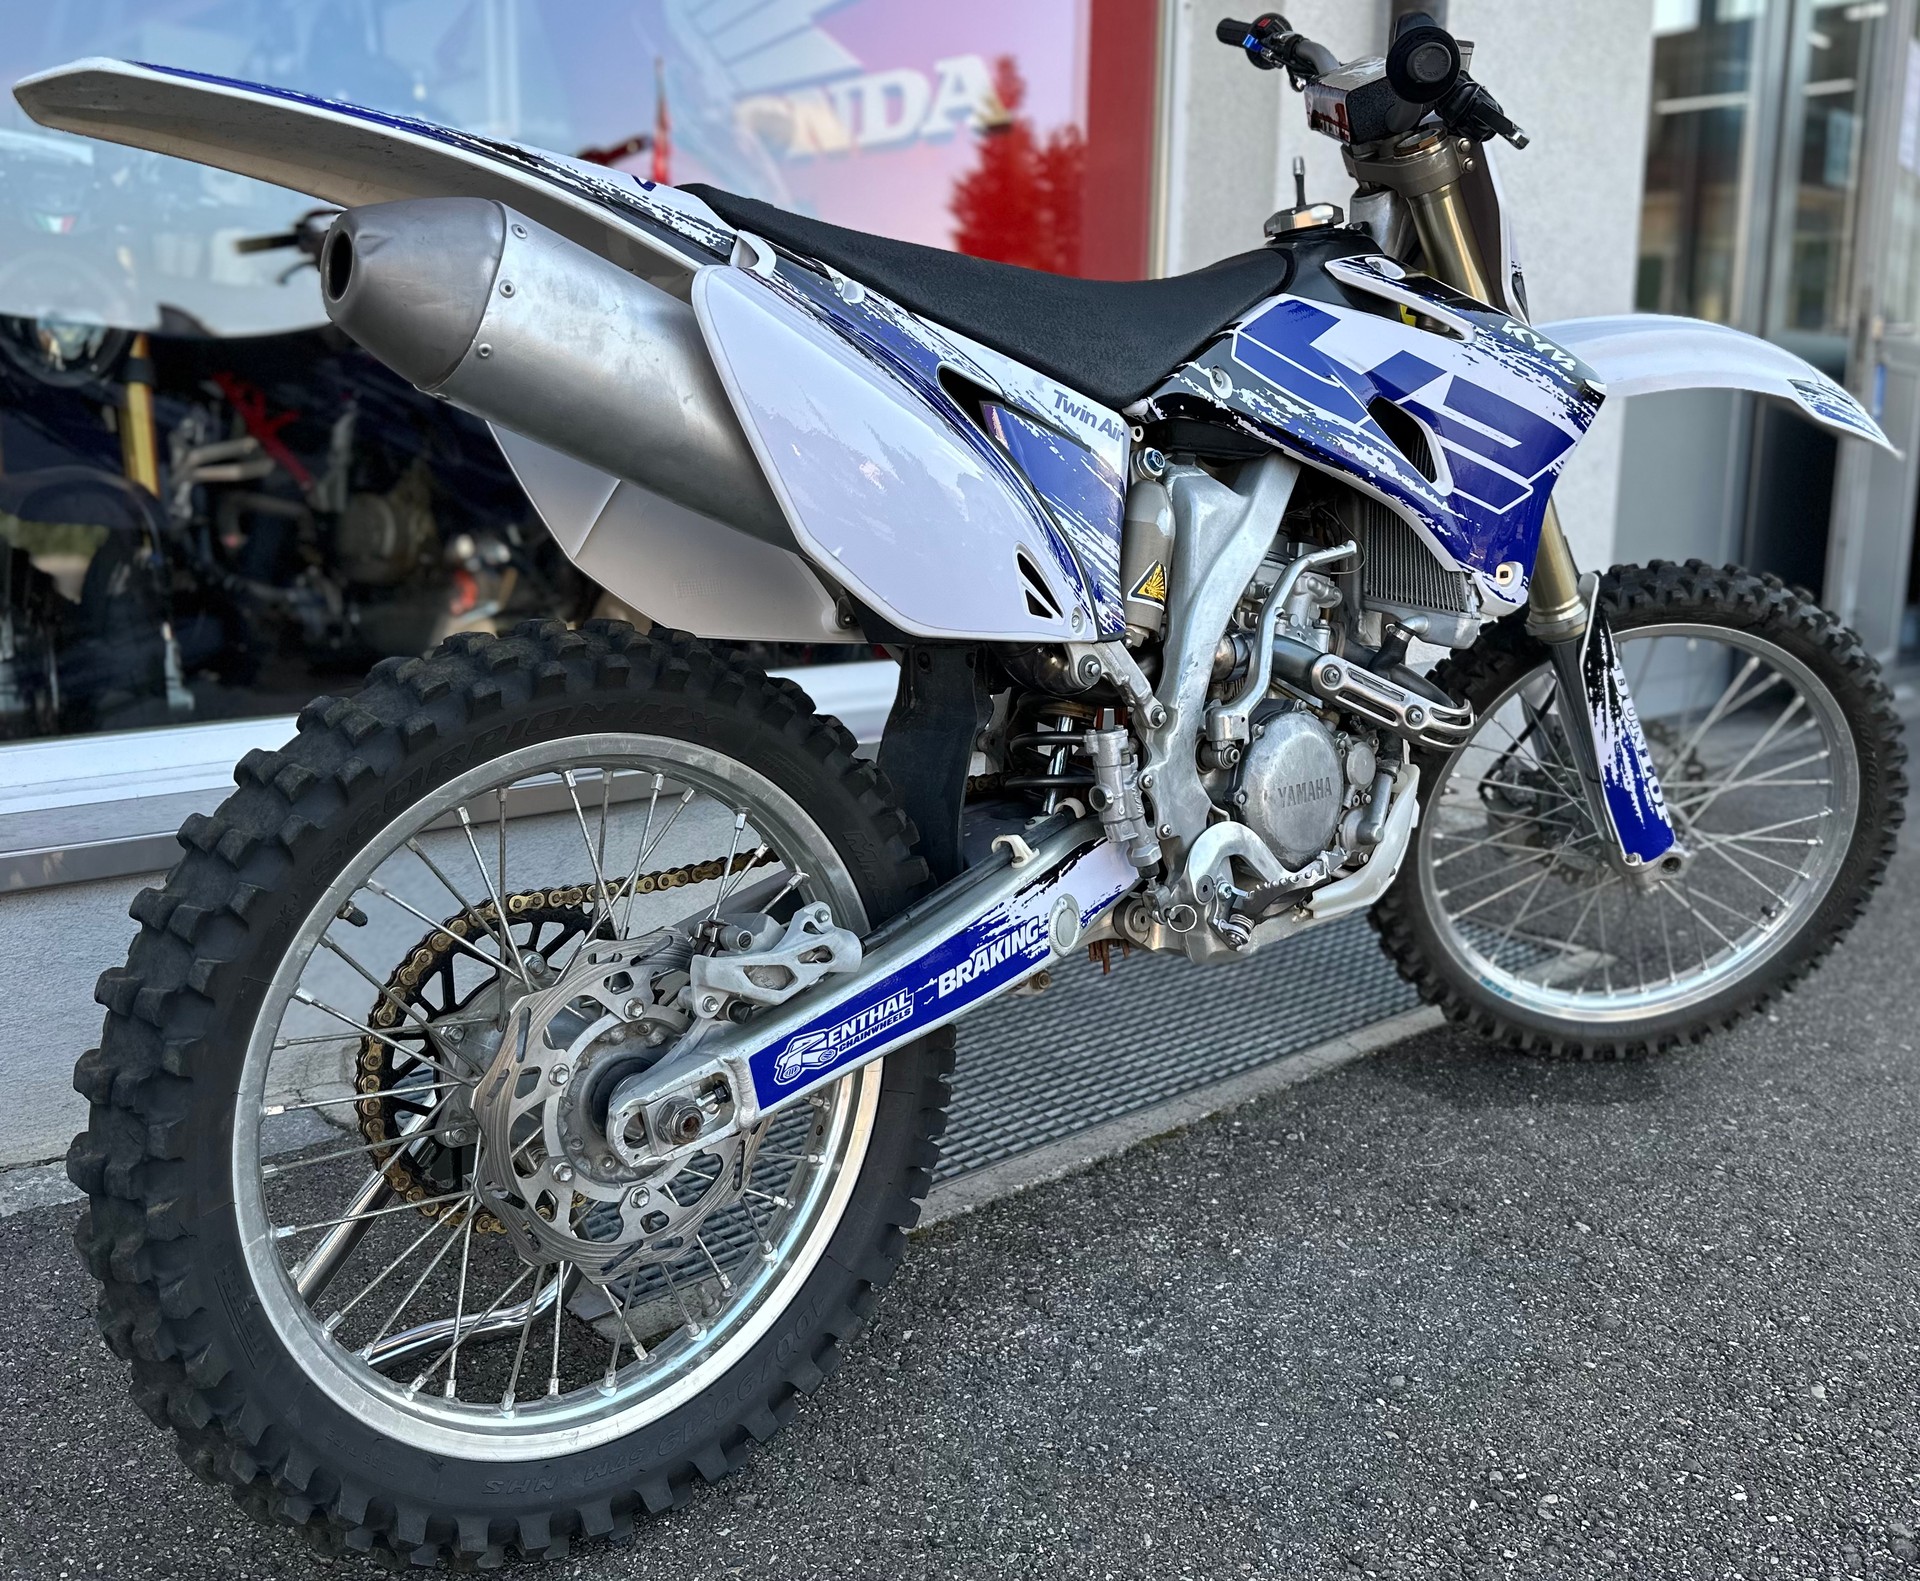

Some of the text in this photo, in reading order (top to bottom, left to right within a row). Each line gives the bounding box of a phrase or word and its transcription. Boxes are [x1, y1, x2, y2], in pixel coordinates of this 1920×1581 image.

[1053, 389, 1124, 442] Twin Air
[1277, 776, 1333, 809] YAMAHA
[938, 916, 1040, 999] BRAKING
[776, 991, 913, 1084] RENTHAL
[838, 1007, 913, 1052] CHAINWHEELS
